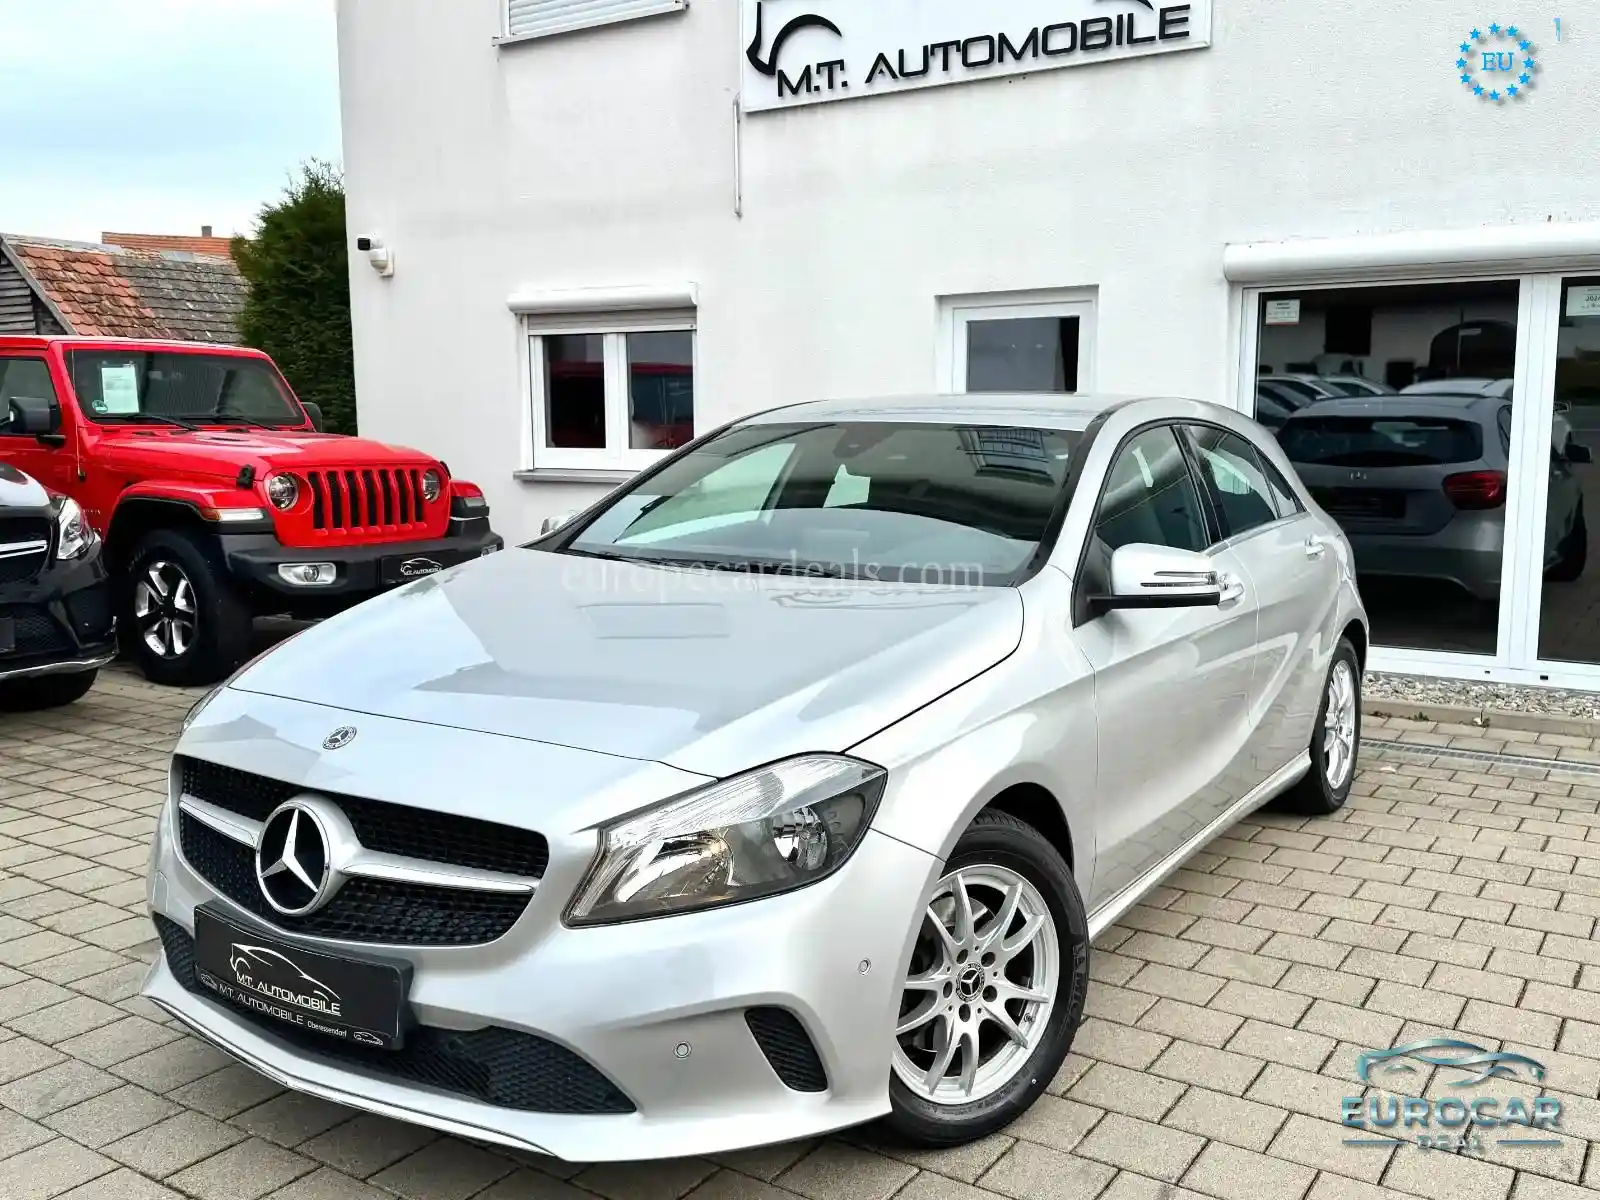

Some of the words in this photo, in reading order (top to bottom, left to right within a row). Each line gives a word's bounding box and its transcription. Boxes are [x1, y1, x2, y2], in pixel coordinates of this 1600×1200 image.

[777, 59, 849, 97] M.T.
[865, 4, 1191, 84] AUTOMOBILE
[236, 971, 254, 989] M.T.
[257, 981, 341, 1015] AUTOMOBILE
[237, 993, 304, 1024] AUTOMOBILE
[307, 1020, 347, 1037] Oberessendorf
